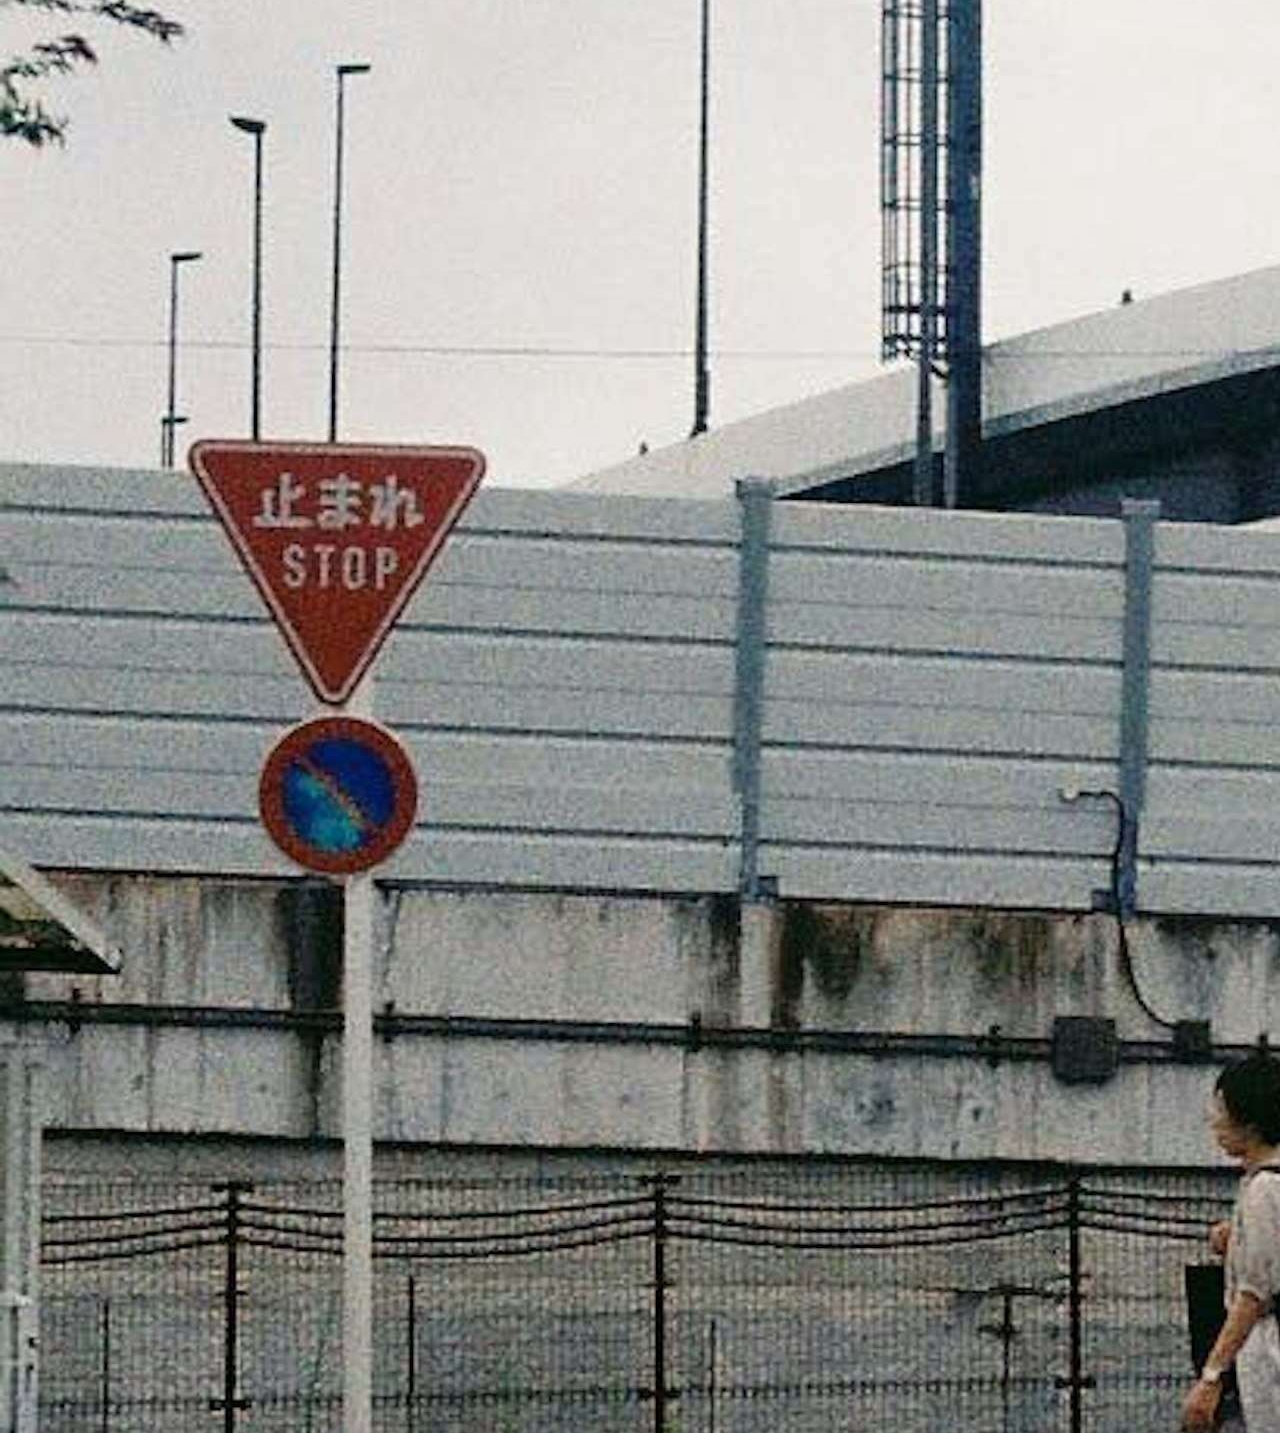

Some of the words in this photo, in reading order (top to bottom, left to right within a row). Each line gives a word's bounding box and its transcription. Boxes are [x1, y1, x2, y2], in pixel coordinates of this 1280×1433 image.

[252, 472, 425, 530] 止まれ
[282, 543, 399, 590] STOP
